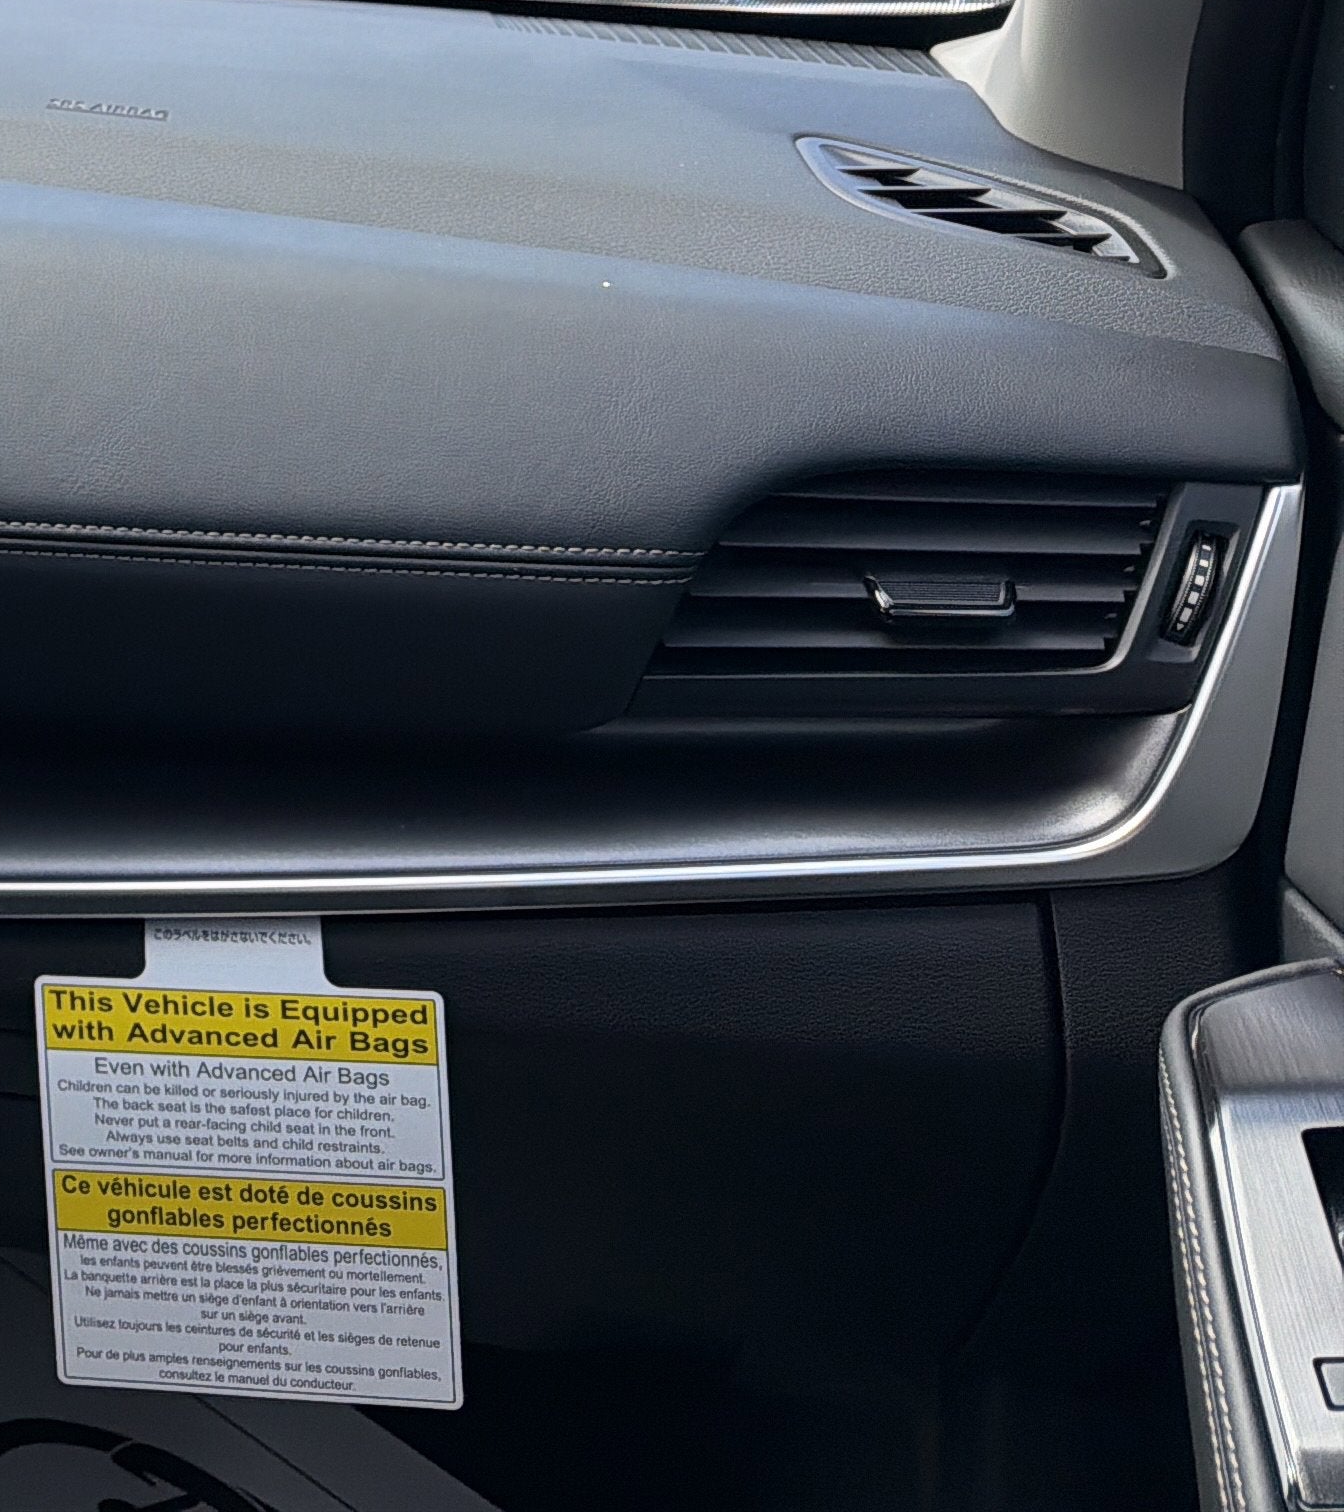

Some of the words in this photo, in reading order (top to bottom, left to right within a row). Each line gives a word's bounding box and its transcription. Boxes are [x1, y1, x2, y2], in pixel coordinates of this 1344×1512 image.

[48, 989, 112, 1012] This
[122, 991, 233, 1017] Vehicle
[244, 997, 269, 1019] is
[280, 999, 427, 1027] Equipped
[52, 1019, 113, 1041] with
[126, 1022, 278, 1048] Advanced
[291, 1029, 336, 1050] Air
[349, 1030, 428, 1058] Bags
[94, 1056, 143, 1075] Even
[150, 1060, 189, 1077] with
[196, 1061, 295, 1081] Advanced
[302, 1066, 331, 1083] Air
[337, 1067, 389, 1088] Bags
[57, 1079, 111, 1092] Children
[116, 1084, 139, 1093] can
[143, 1082, 160, 1095] be
[164, 1083, 198, 1096] killed
[202, 1088, 215, 1097] or
[220, 1086, 279, 1102] seriously
[283, 1089, 328, 1103] injured
[333, 1090, 349, 1105] by
[353, 1092, 374, 1104] the
[379, 1093, 396, 1105] air
[400, 1094, 430, 1109] bag.
[93, 1096, 118, 1109] The
[122, 1098, 153, 1110] back
[158, 1101, 186, 1112] seat
[190, 1101, 200, 1112] is
[205, 1102, 225, 1114] the
[230, 1103, 270, 1116] safest
[274, 1105, 310, 1117] place
[314, 1106, 332, 1118] for
[337, 1108, 394, 1121] children.
[95, 1112, 133, 1126] Never
[137, 1116, 158, 1127] put
[162, 1118, 170, 1127] a
[175, 1117, 246, 1133] rear-facing
[250, 1120, 281, 1132] child
[286, 1123, 314, 1134] seat
[318, 1123, 330, 1134] in
[334, 1124, 355, 1136] the
[360, 1125, 394, 1137] front.
[106, 1130, 152, 1143] Always
[157, 1135, 180, 1144] use
[185, 1135, 213, 1145] seat
[217, 1134, 248, 1147] belts
[253, 1137, 277, 1148] and
[282, 1138, 313, 1150] child
[318, 1141, 384, 1153] restraints.
[59, 1143, 84, 1156] See
[88, 1146, 139, 1158] owner's
[143, 1149, 191, 1160] manual
[196, 1150, 213, 1161] for
[217, 1153, 251, 1163] more
[256, 1153, 330, 1167] information
[335, 1157, 373, 1169] about
[377, 1160, 395, 1170] air
[398, 1160, 436, 1174] bags.
[61, 1174, 90, 1194] Ce
[97, 1177, 190, 1199] véhicule
[198, 1183, 232, 1201] est
[239, 1183, 289, 1204] doté
[296, 1186, 324, 1206] de
[331, 1192, 436, 1211] coussins
[107, 1205, 224, 1228] gonflables
[232, 1211, 391, 1237] perfectionnés
[63, 1233, 108, 1250] Même
[112, 1238, 147, 1252] avec
[151, 1238, 178, 1254] des
[182, 1242, 246, 1258] coussins
[251, 1245, 328, 1262] gonflables
[333, 1250, 442, 1270] perfectionnés,
